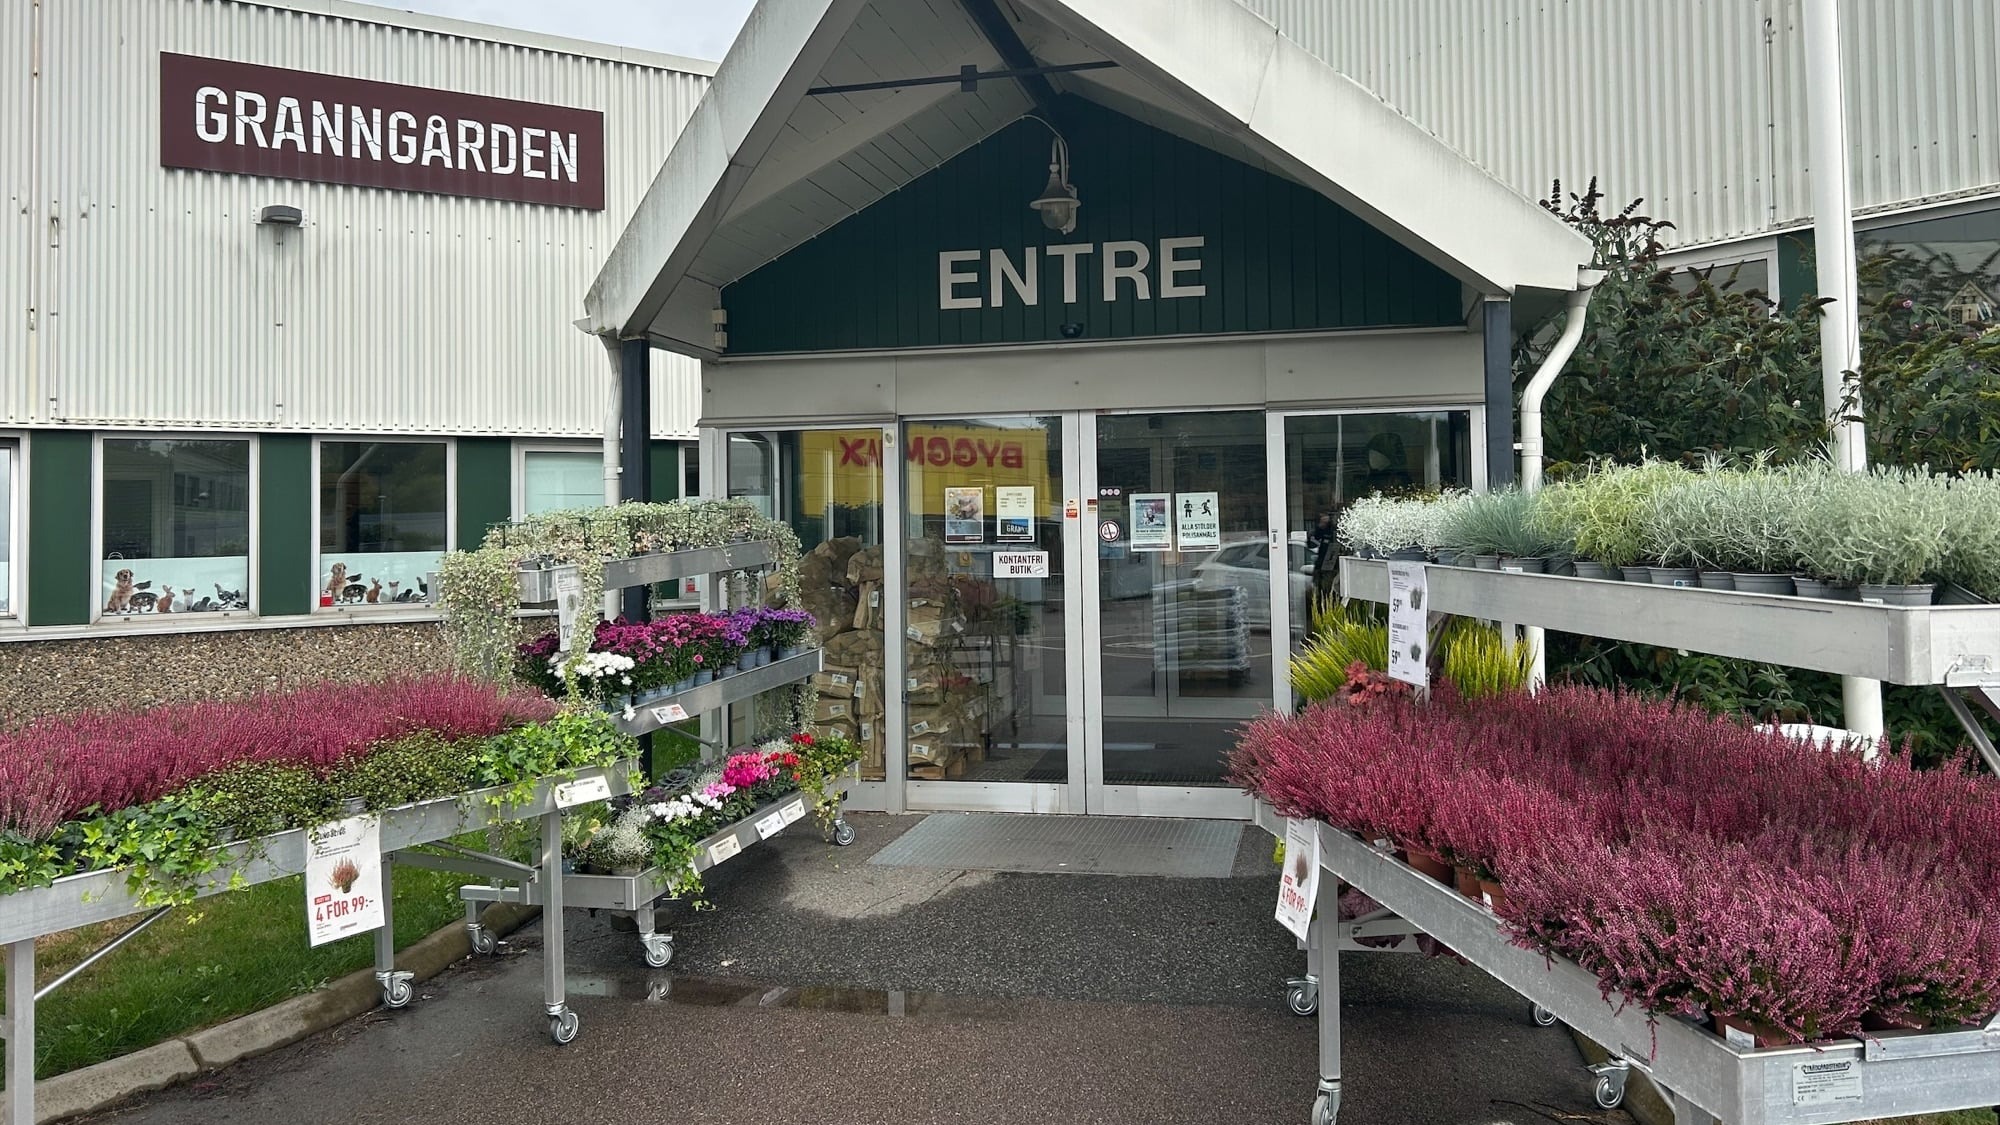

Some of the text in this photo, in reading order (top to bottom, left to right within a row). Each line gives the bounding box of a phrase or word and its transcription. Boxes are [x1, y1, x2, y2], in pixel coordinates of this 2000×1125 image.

[195, 86, 578, 183] GRANNGÅRDEN
[939, 236, 1206, 310] ENTRE
[998, 555, 1043, 565] KONTANTFRI
[1010, 565, 1032, 574] BUTIK
[316, 907, 324, 922] 4
[326, 900, 349, 920] FÖR
